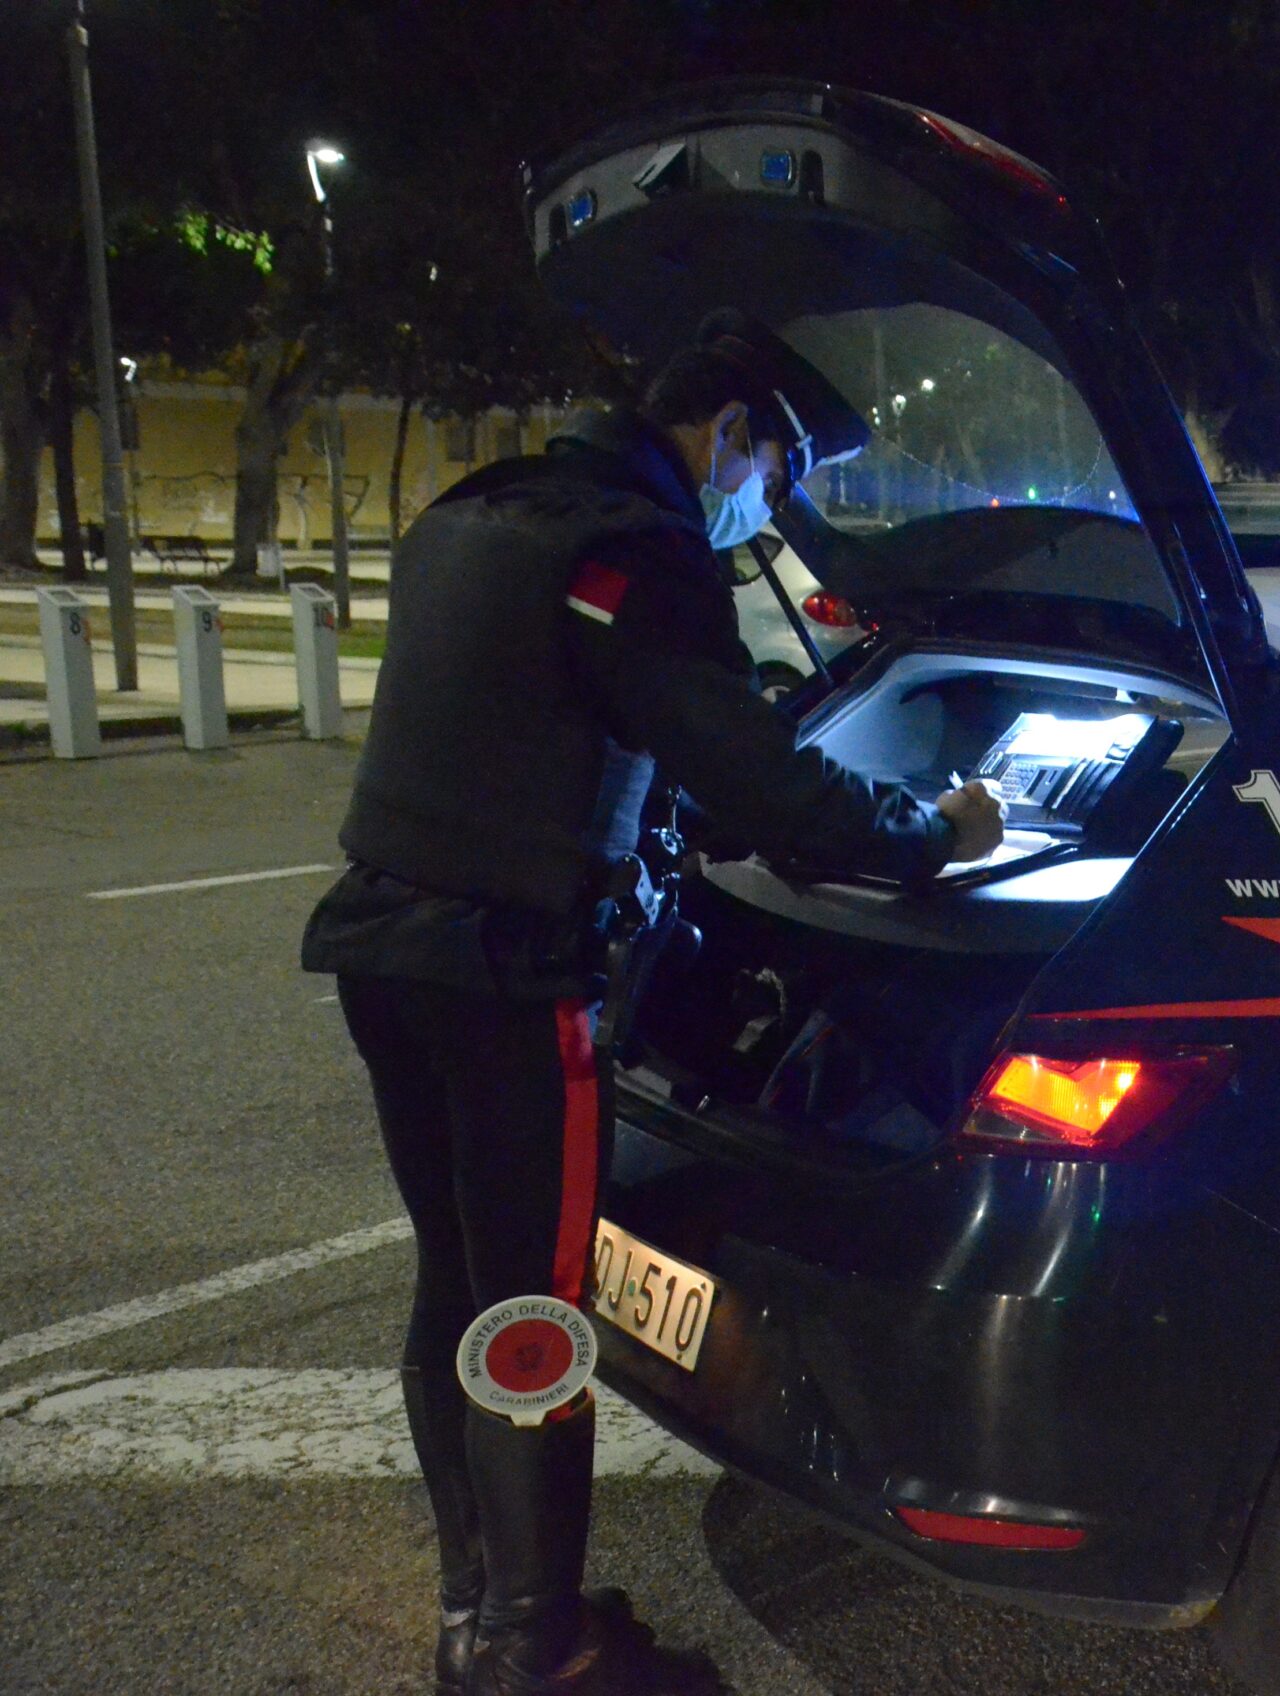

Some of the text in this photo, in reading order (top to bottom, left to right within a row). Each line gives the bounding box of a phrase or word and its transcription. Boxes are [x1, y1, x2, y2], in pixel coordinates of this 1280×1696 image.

[70, 611, 81, 635] 8
[202, 610, 212, 632] 9
[634, 1262, 704, 1352] 510
[467, 1303, 590, 1379] MINISTERO DELLA DIFESA
[489, 1383, 569, 1406] CARABINIERI
